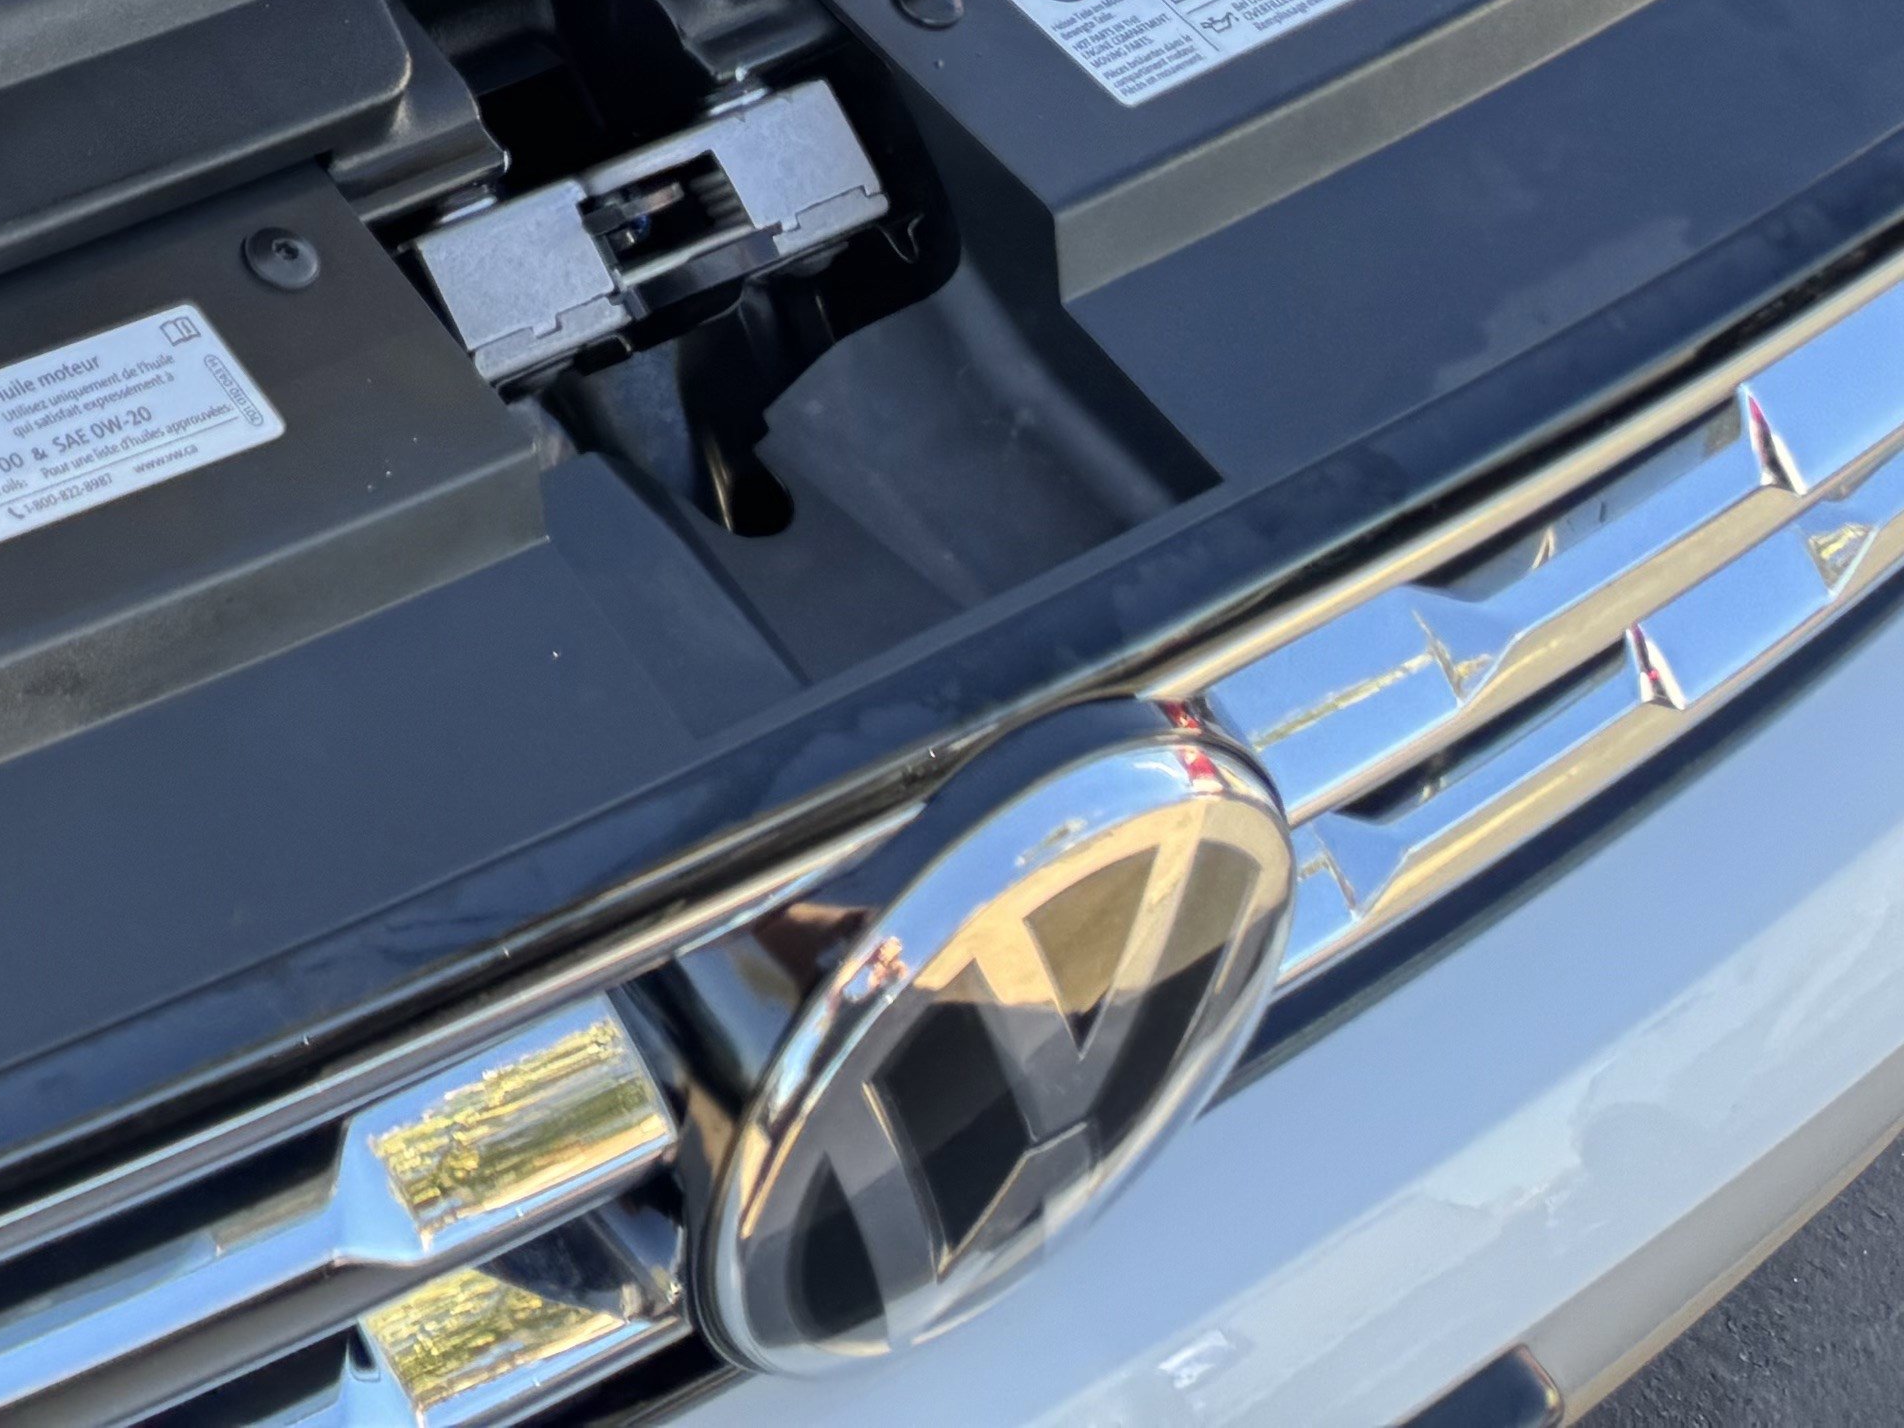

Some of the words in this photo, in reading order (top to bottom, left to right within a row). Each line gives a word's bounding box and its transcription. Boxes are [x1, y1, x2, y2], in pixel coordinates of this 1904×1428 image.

[0, 399, 49, 422] Utilisez
[47, 372, 122, 406] uniquement
[121, 366, 138, 381] de
[37, 355, 99, 387] moteur
[11, 421, 35, 438] qui
[34, 404, 83, 429] satisfait
[30, 446, 49, 461] &
[51, 427, 90, 453] SAE
[89, 405, 152, 439] 0W-20
[24, 472, 112, 513] 1-800-822-8987
[133, 444, 199, 473] www.vw.ca
[38, 461, 70, 479] Pour
[70, 453, 94, 469] une
[91, 443, 120, 460] liste
